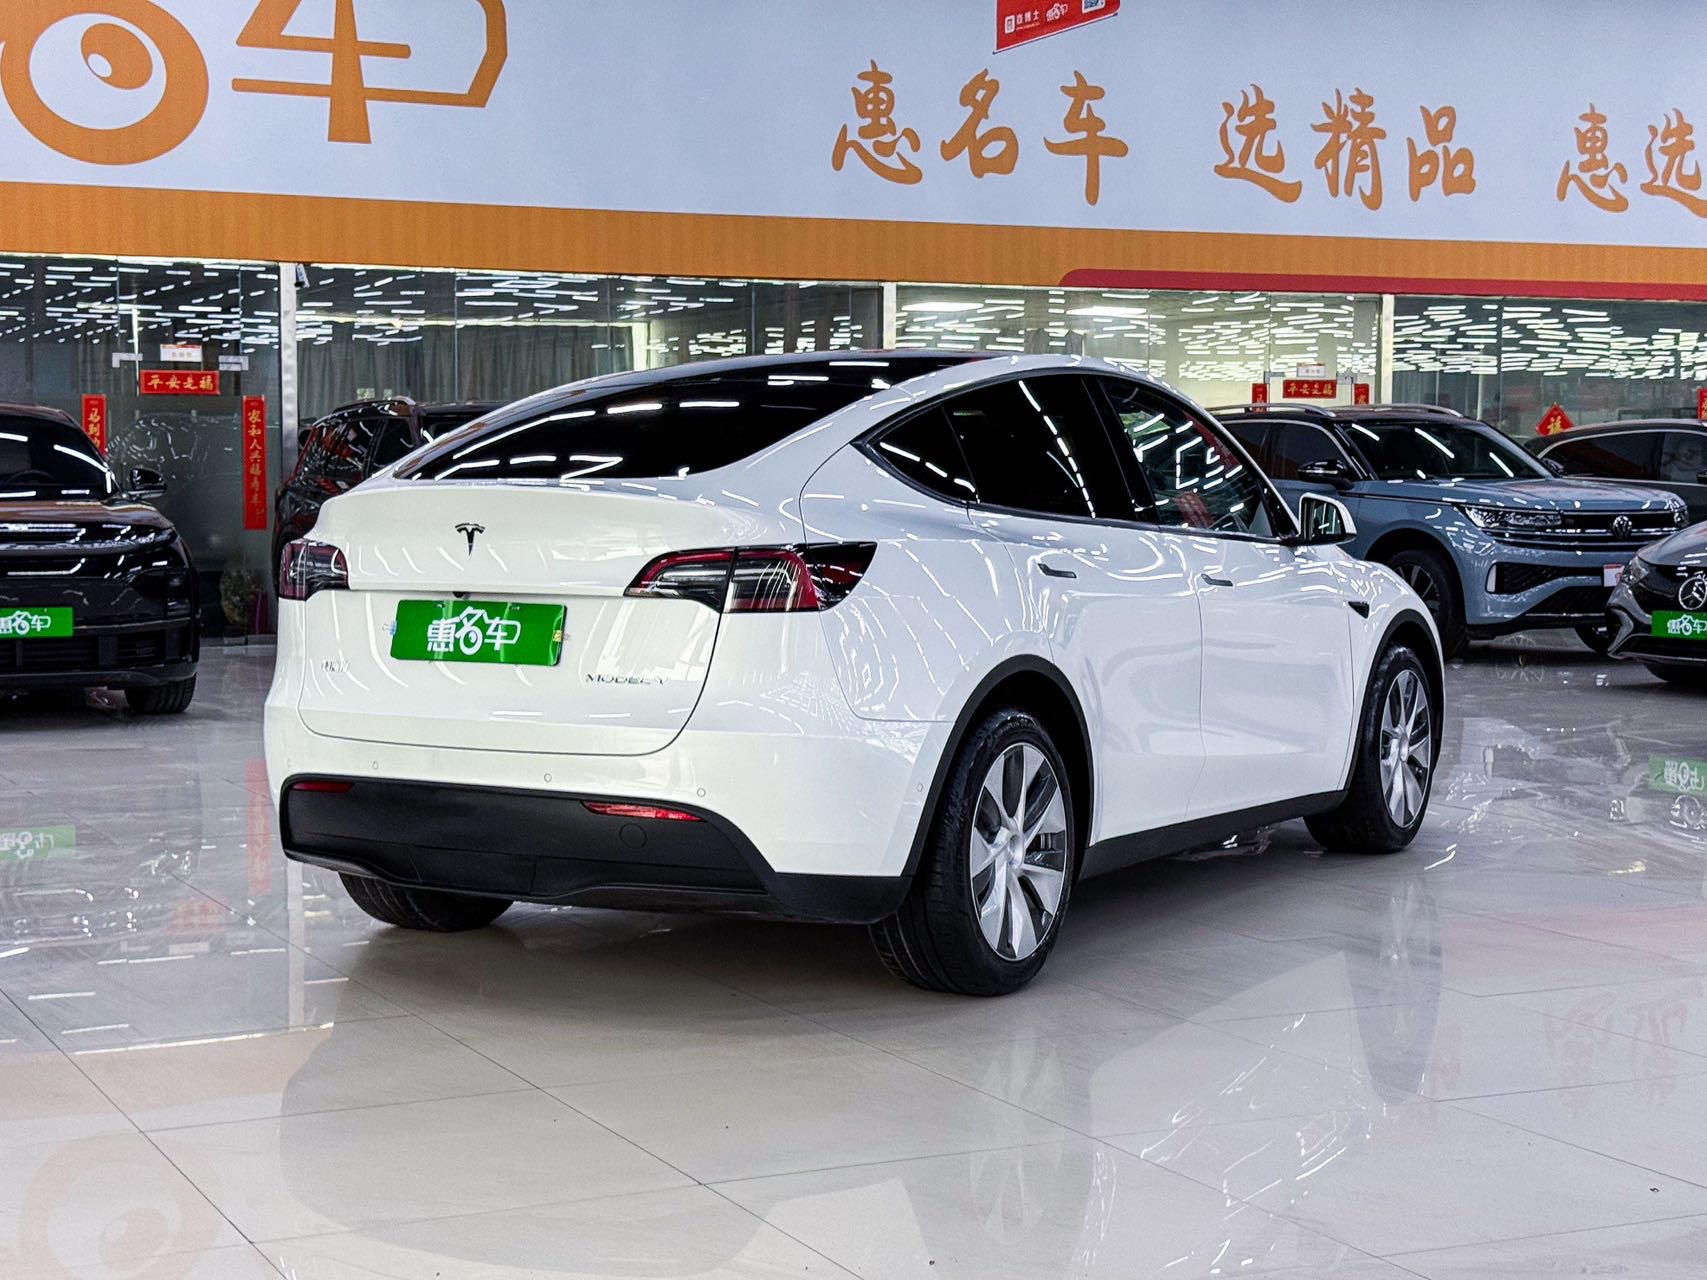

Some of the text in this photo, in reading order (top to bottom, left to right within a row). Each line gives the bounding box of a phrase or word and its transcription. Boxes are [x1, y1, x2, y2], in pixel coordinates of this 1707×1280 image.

[832, 59, 1707, 218] 惠名车 选精品 惠选
[427, 605, 522, 656] 惠名车
